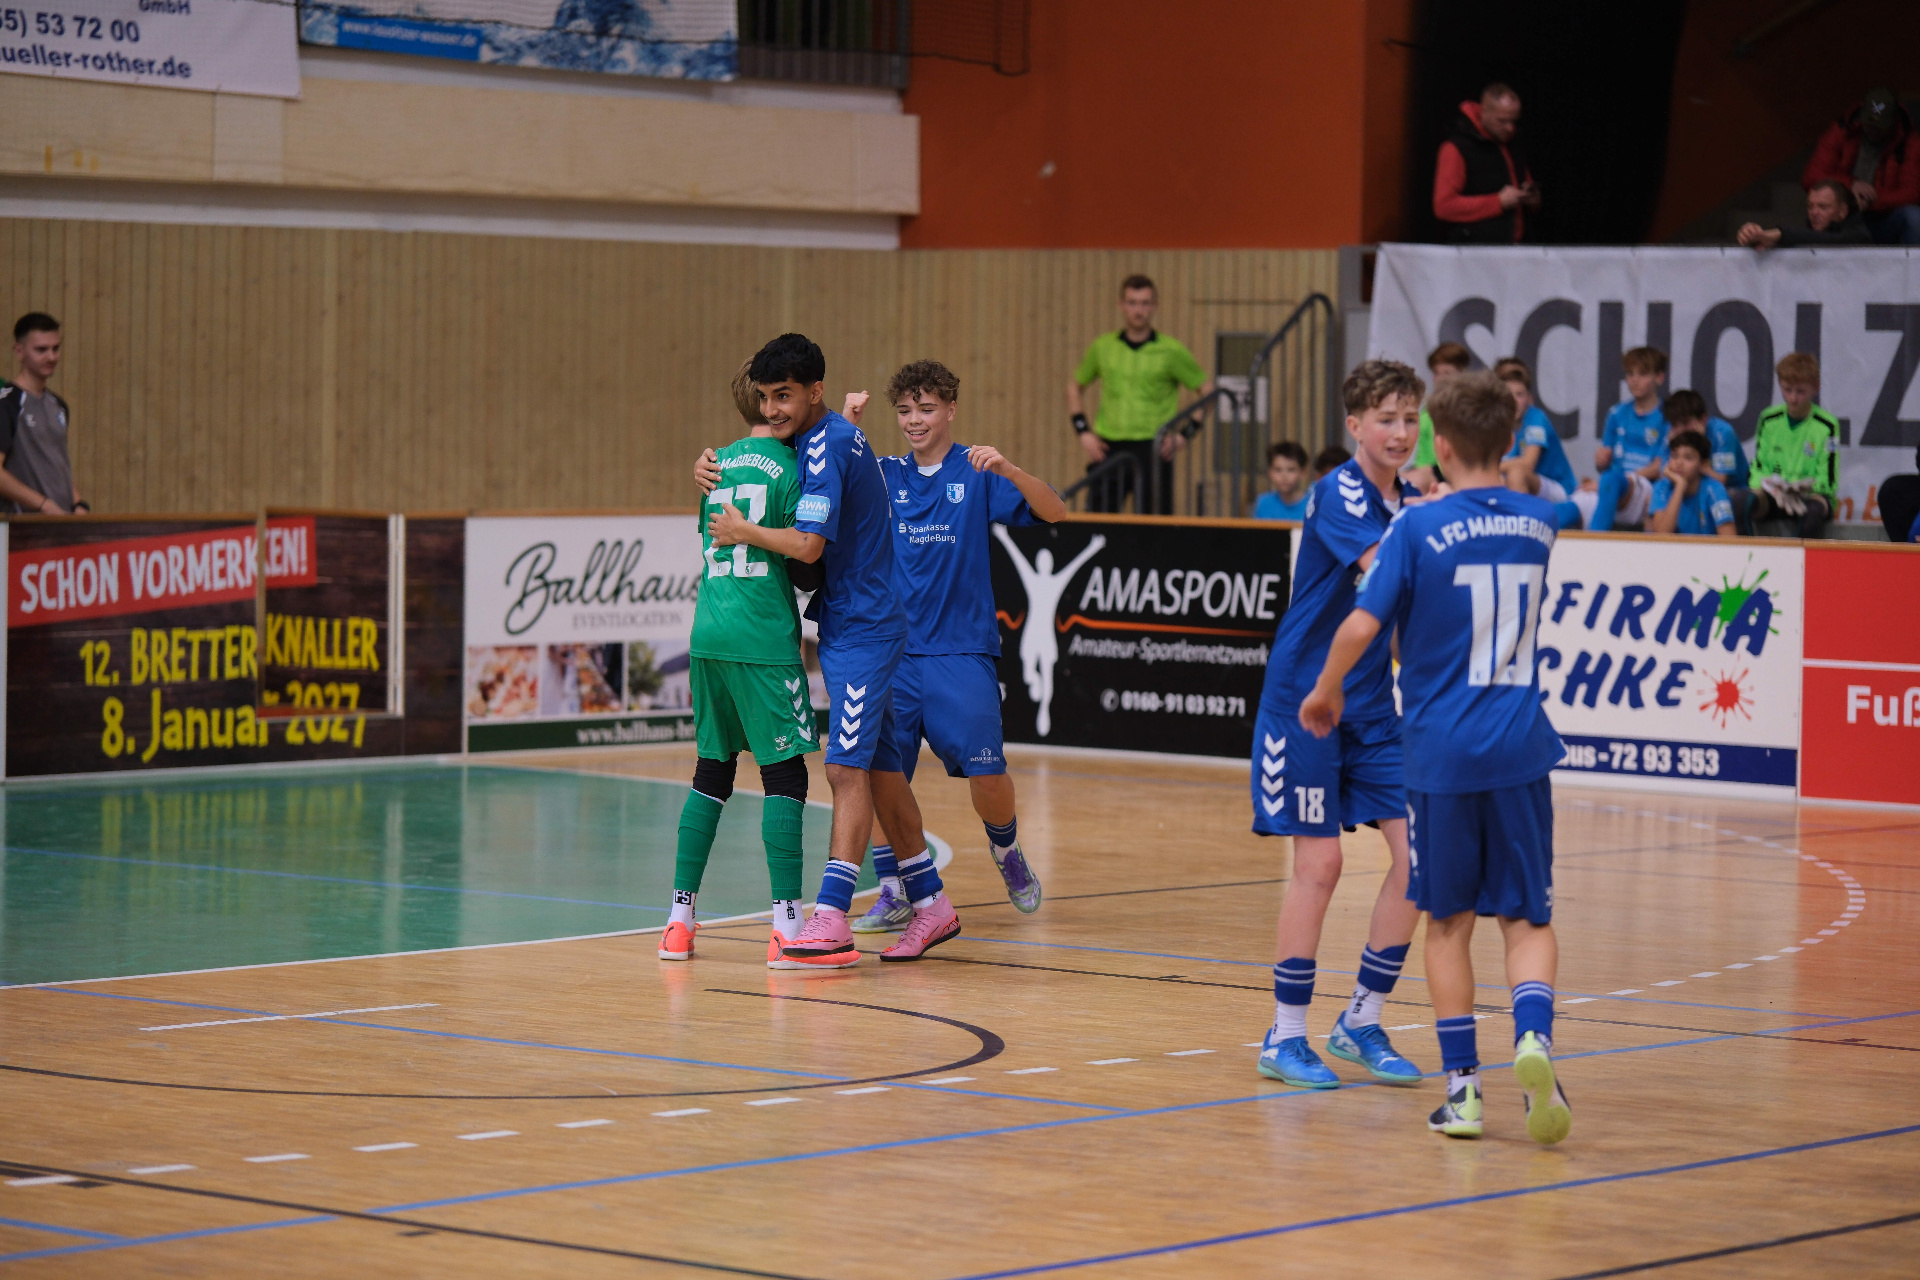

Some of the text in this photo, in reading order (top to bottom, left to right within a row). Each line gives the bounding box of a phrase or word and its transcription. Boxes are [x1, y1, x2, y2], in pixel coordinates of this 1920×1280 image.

[0, 8, 140, 43] 5) 53 72 00
[0, 43, 192, 79] ueller-rother.de
[720, 453, 784, 480] MAGDEBURG
[798, 500, 827, 513] SWM
[908, 524, 950, 535] Sparkasse
[20, 526, 308, 614] SCHON VORMERKEN!
[1079, 566, 1281, 620] AMASPONE
[1453, 564, 1545, 687] 10
[79, 639, 120, 687] 12.
[102, 695, 136, 759] 8.
[285, 680, 366, 748] 2027
[1847, 685, 1920, 728] Fuß
[1642, 743, 1673, 774] 93
[1676, 746, 1720, 777] 353
[1294, 786, 1326, 825] 18
